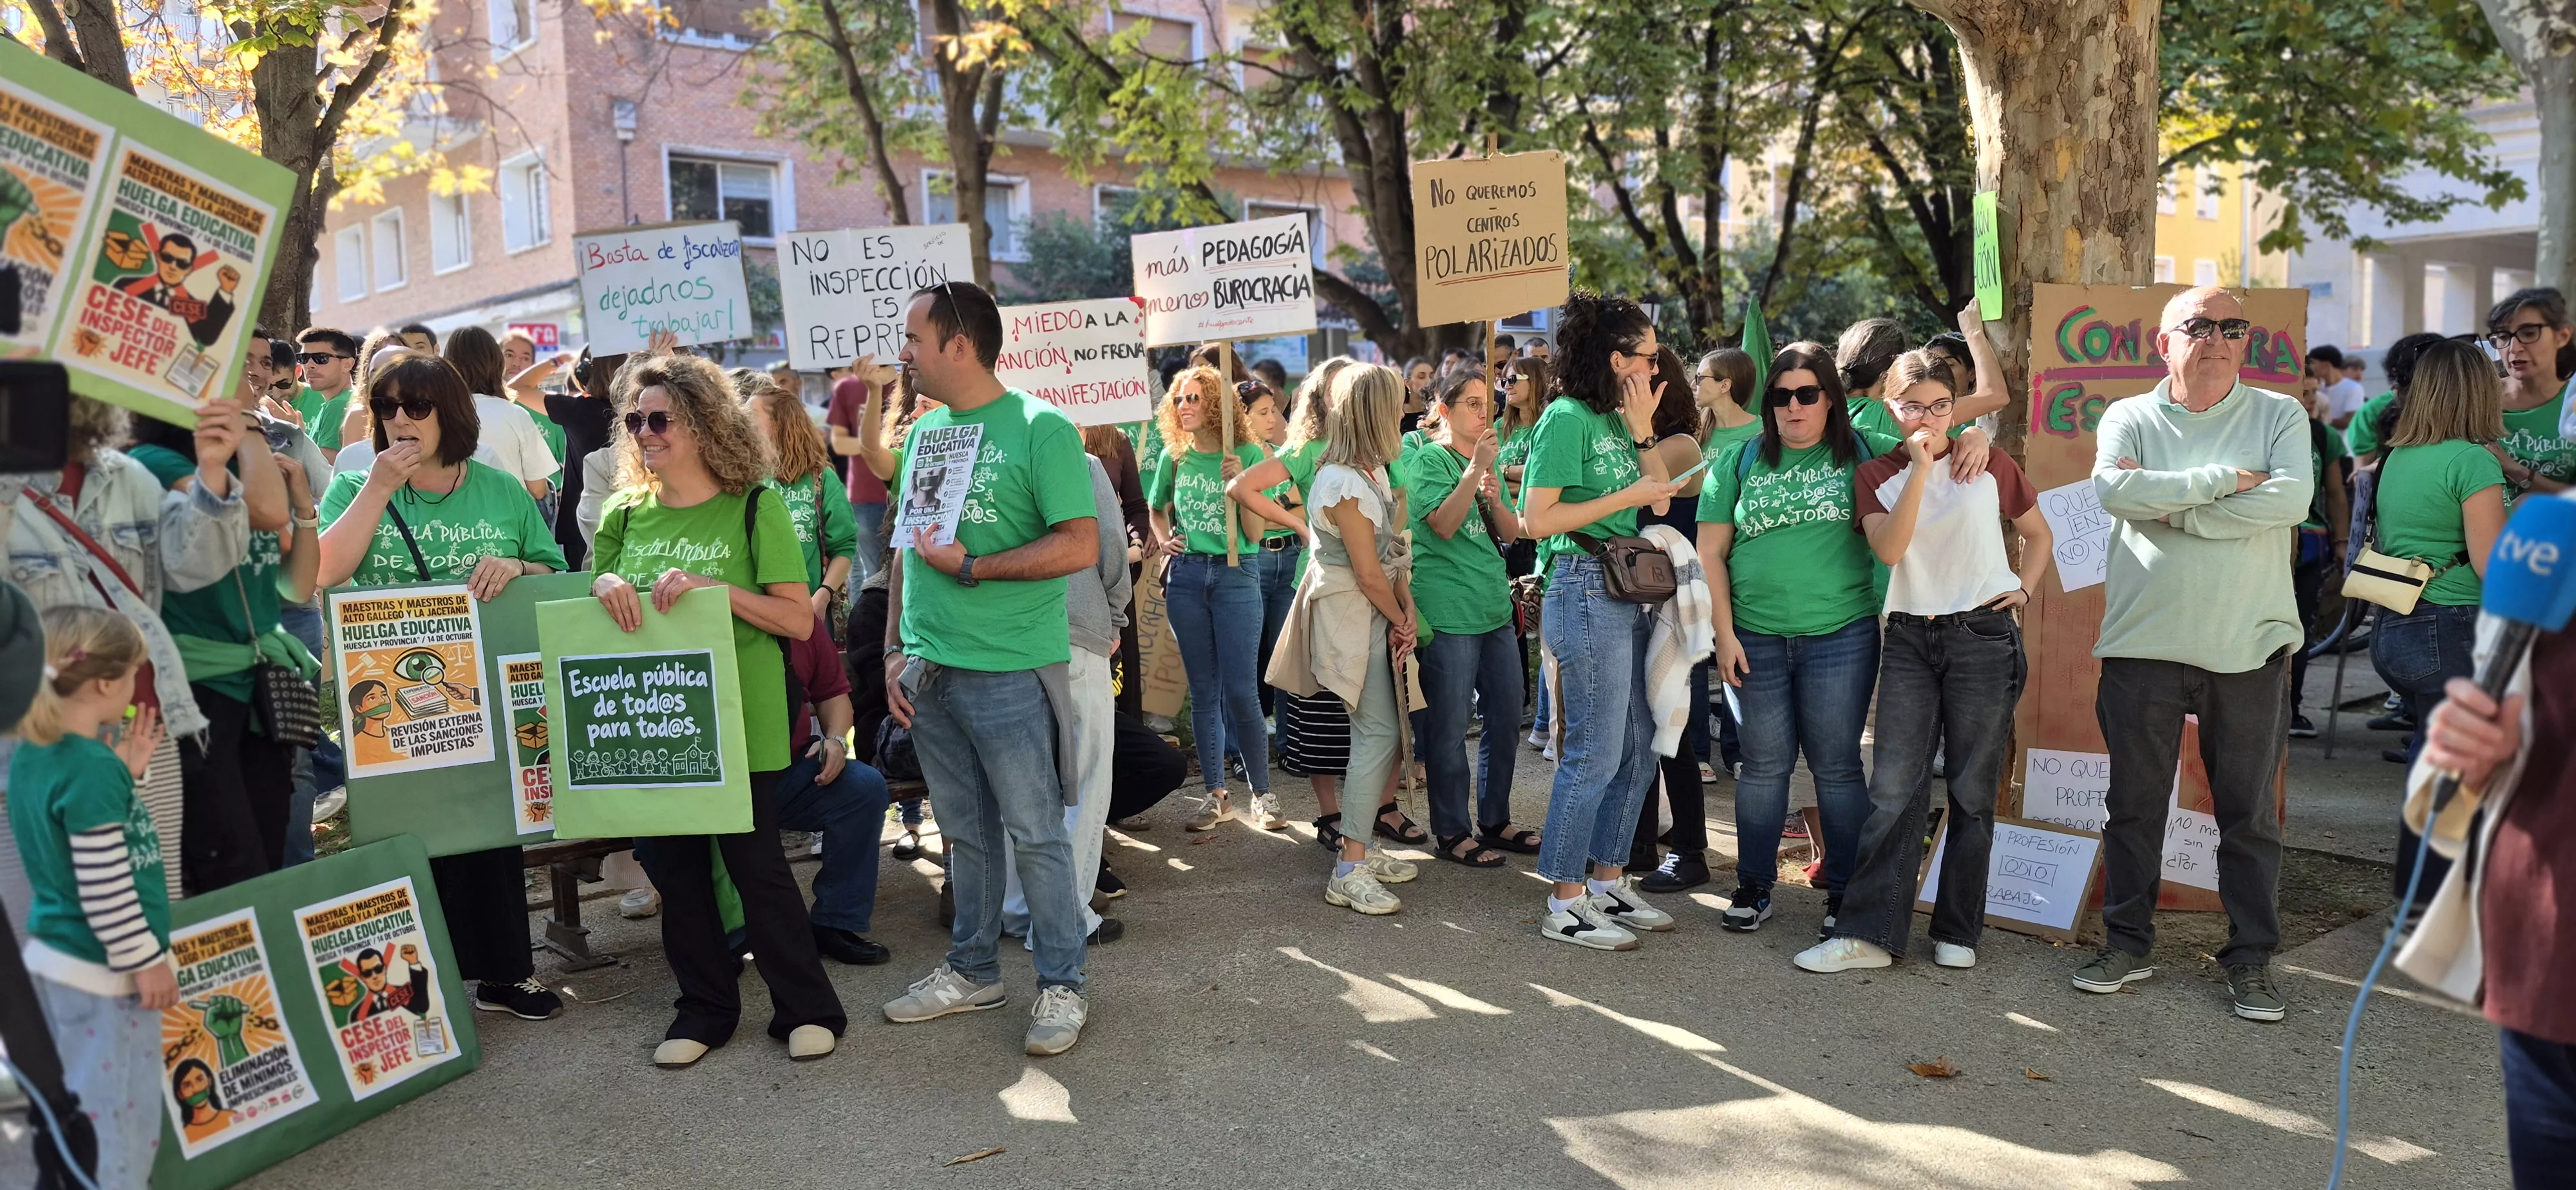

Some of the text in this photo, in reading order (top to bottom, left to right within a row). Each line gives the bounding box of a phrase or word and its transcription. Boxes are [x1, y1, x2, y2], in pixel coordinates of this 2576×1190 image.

[129, 153, 265, 224] MAESTRAS Y MAESTROS DE
[1466, 181, 1537, 201] QUEREMOS
[124, 165, 261, 236] ALTO GALLEGO LA JACETANIA
[118, 178, 256, 254] HUELGA EDUCATIVA
[1466, 212, 1520, 232] CENTROS
[578, 238, 649, 276] ¡Basta
[658, 240, 676, 259] de
[791, 235, 894, 265] NO ES
[1145, 223, 1305, 279] más PEDAGOGÍA
[174, 301, 202, 316] CESE
[600, 276, 714, 321] dejadnos
[872, 297, 898, 318] ES
[1147, 291, 1209, 316] menos
[86, 284, 153, 327] CESE
[151, 317, 178, 340] DEL
[631, 298, 734, 342] trabajar!
[1085, 314, 1097, 328] A
[1104, 310, 1130, 326] LA
[80, 308, 176, 357] INSPECTOR
[997, 341, 1146, 372] ANCIÓN NO FRENA
[2031, 371, 2108, 440] ¡ES
[917, 437, 976, 456] EDUCATIVA
[919, 425, 979, 446] HUELGA
[949, 451, 969, 460] HUESCA
[1200, 477, 1225, 494] PÚBLI
[1748, 485, 1840, 511] DE TOD@S
[2049, 486, 2100, 517] QUE
[1792, 507, 1851, 523] TOD@S
[440, 522, 507, 543] PÚBLICA:
[373, 553, 404, 569] DE
[2060, 543, 2085, 563] NO
[2499, 529, 2560, 576] tve
[627, 572, 649, 588] DE
[343, 596, 467, 614] MAESTRAS Y MAESTROS DE
[343, 605, 469, 623] ALTO GALLEGO Y LA JACETANIA
[342, 616, 473, 641] HUELGA EDUCATIVA
[344, 639, 372, 650] HUESCA
[374, 639, 379, 647] Y
[446, 632, 473, 641] OCTUBRE
[509, 663, 542, 674] MAEST
[510, 672, 530, 683] ALTO
[568, 661, 708, 698] Escuela pública
[411, 691, 439, 704] SANCIÓN
[512, 698, 538, 707] HUESCA
[592, 688, 687, 719] de tod@s
[438, 712, 483, 729] EXTERNA
[587, 715, 701, 748] para tod@s.
[392, 723, 484, 749] DE LAS SANCIONES
[2032, 757, 2109, 779] NO QUE
[2056, 786, 2107, 808] PROFE
[2199, 824, 2219, 836] me
[2183, 836, 2204, 849] sin
[2004, 858, 2048, 880] ODIO
[1985, 884, 2044, 907] RABAJO
[306, 889, 407, 927] MAESTRAS Y MAESTROS DE
[308, 898, 410, 936] ALTO GALLEGO Y LA JACETANIA
[311, 909, 414, 956] HUELGA EDUCATIVA
[377, 934, 384, 943] 14
[384, 932, 392, 941] DE
[393, 923, 417, 938] OCTUBRE
[196, 945, 261, 981] EDUCATIVA
[390, 987, 410, 1007] CESE
[341, 1015, 407, 1048] CESE DEL
[347, 1027, 412, 1064] INSPECTOR
[219, 1044, 289, 1084] ELIMINACIÓN
[223, 1082, 240, 1099] DE
